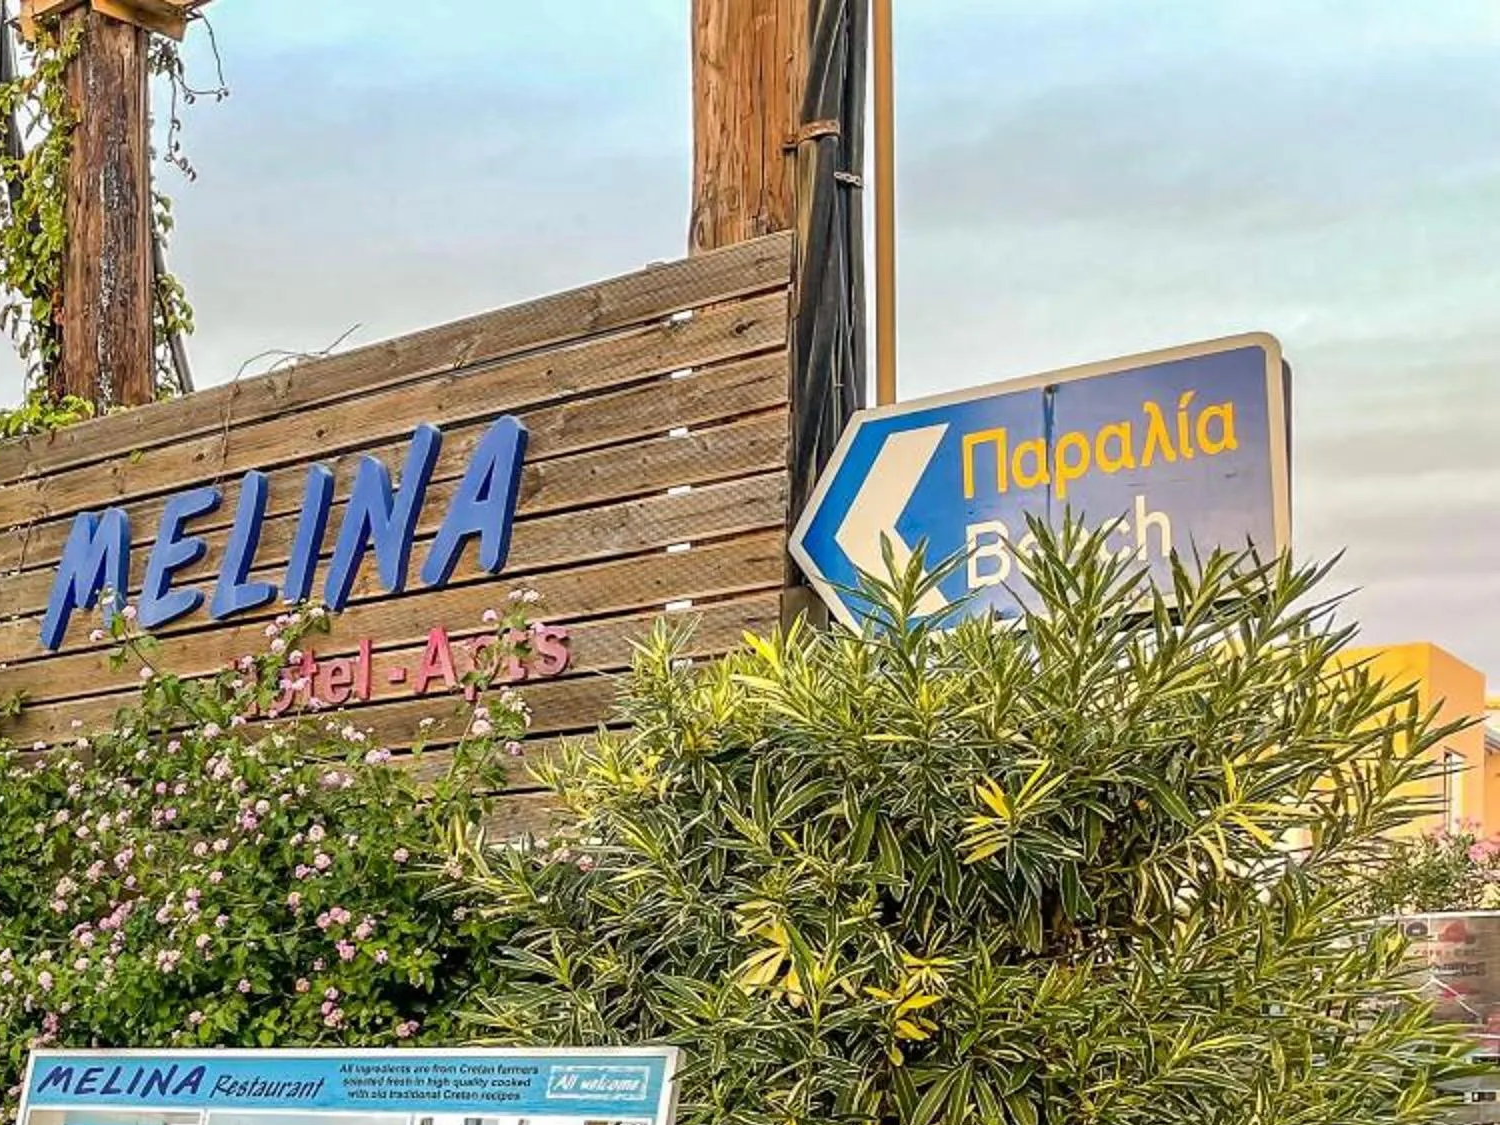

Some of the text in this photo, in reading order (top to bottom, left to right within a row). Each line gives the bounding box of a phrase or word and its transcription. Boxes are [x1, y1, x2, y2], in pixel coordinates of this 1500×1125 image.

[962, 391, 1238, 499] Παραλία
[39, 414, 528, 651] MELINA
[227, 639, 372, 715] tel
[37, 1064, 325, 1099] MELINA Restaurant
[427, 1077, 451, 1088] high
[453, 1078, 488, 1088] quality
[491, 1078, 531, 1087] cooked
[431, 1064, 457, 1074] from
[460, 1064, 495, 1074] Cretan
[497, 1064, 539, 1075] farmers
[444, 1090, 479, 1100] Cretan
